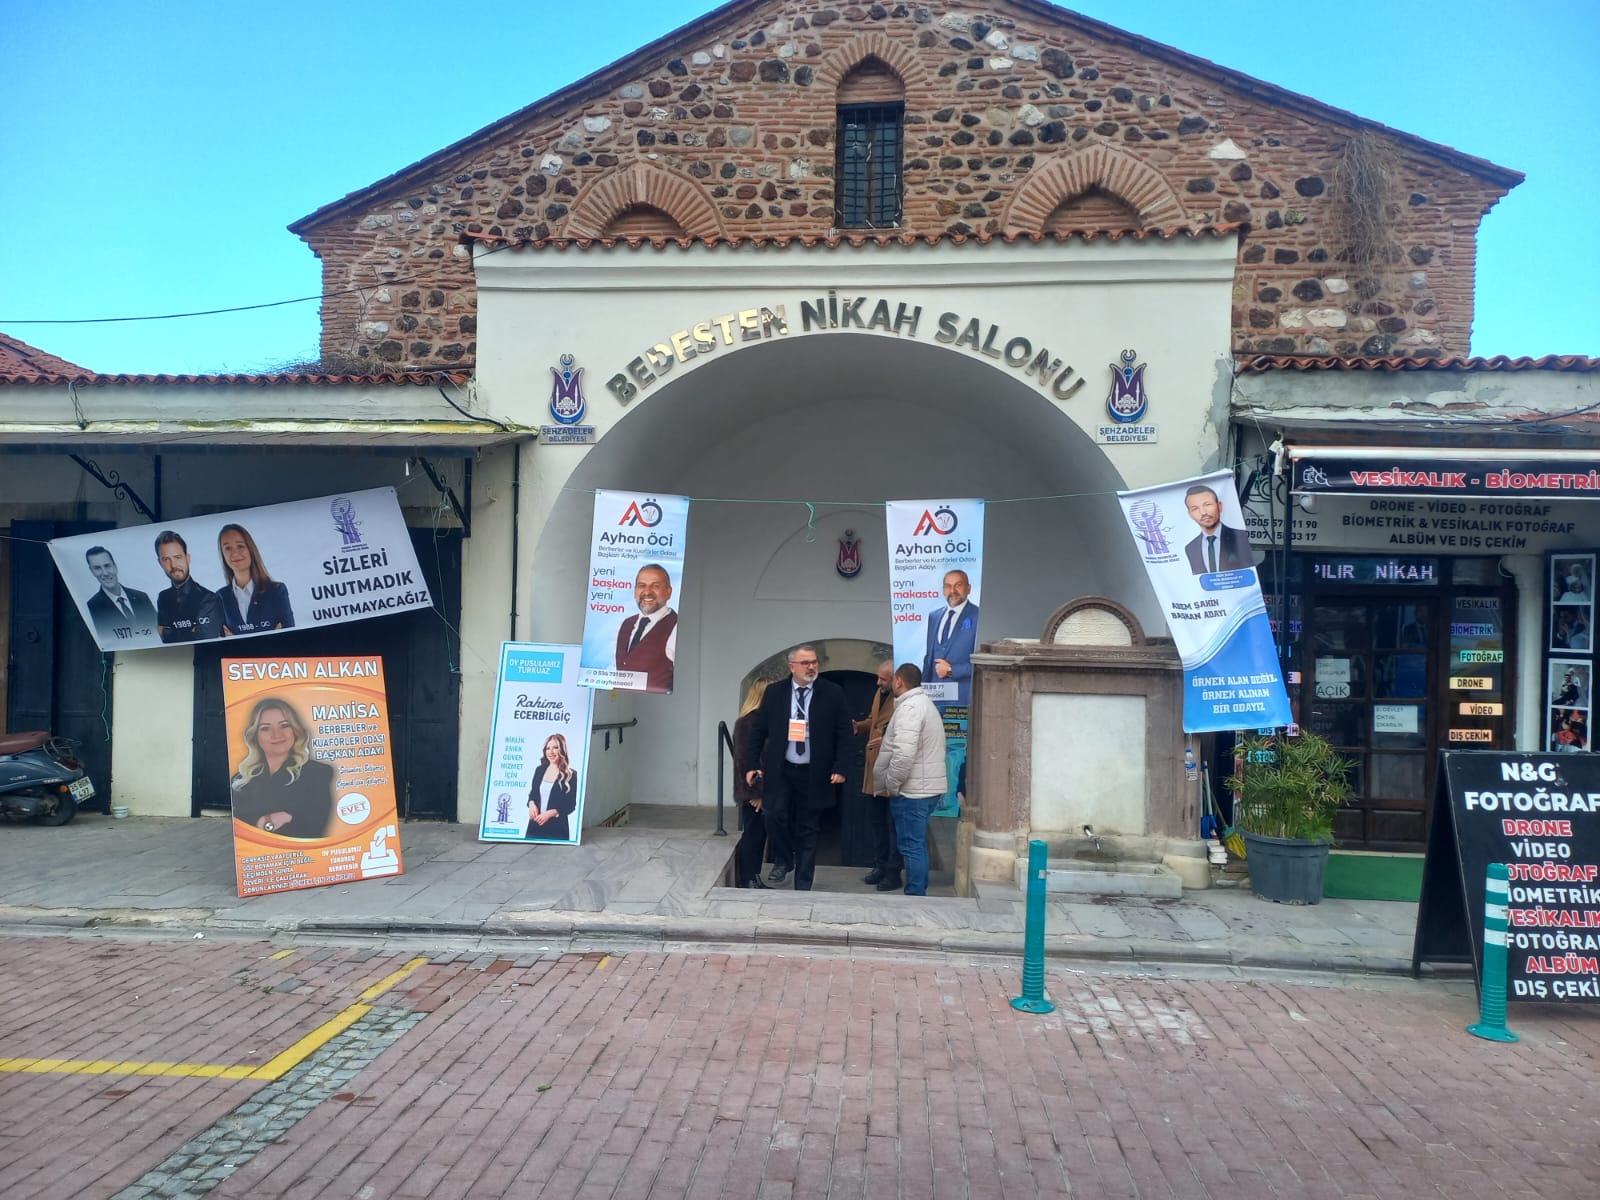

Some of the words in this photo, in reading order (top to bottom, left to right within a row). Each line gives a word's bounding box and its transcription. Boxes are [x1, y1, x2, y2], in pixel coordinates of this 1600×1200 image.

[606, 304, 789, 406] BEDESTEN
[799, 289, 923, 337] NİKAH
[934, 311, 1086, 400] SALONU
[1350, 467, 1466, 489] VESİKALIK
[1370, 500, 1415, 512] DRONE
[1427, 500, 1467, 514] VİDEO
[1479, 501, 1552, 516] FOTOĞRAF
[1246, 518, 1269, 527] 0505
[1306, 520, 1318, 528] 90
[1342, 515, 1416, 529] BİOMETRİK
[1419, 519, 1428, 529] &
[1431, 518, 1503, 532] VESİKALIK
[1506, 519, 1576, 534] FOTOĞRAF
[600, 531, 644, 548] Ayhan
[1306, 533, 1317, 541] 17
[1390, 532, 1436, 546] ALBÜM
[1440, 536, 1456, 546] VE
[1460, 536, 1481, 548] DIŞ
[1485, 534, 1527, 549] ÇEKİM
[896, 542, 942, 557] Ayhan
[323, 547, 388, 576] SİZLERİ
[593, 566, 615, 577] yeni
[1376, 561, 1433, 579] NİKAH
[311, 570, 414, 602] UNUTMADIK
[592, 577, 632, 590] başkan
[893, 579, 914, 590] aynı
[591, 590, 613, 601] yeni
[893, 590, 939, 599] makasta
[312, 589, 429, 621] UNUTMAYACAĞIZ
[590, 602, 625, 614] vizyon
[893, 602, 914, 612] aynı
[894, 614, 922, 624] yolda
[1203, 609, 1227, 619] ADAYI
[172, 619, 192, 630] 1989
[113, 627, 132, 640] 1977
[1461, 650, 1503, 662] FOTOĞRAF
[228, 660, 308, 681] SEVCAN
[314, 660, 379, 678] ALKAN
[1192, 676, 1226, 687] ÖRNEK
[1228, 674, 1249, 686] ALAN
[1457, 678, 1484, 688] DRONE
[1202, 689, 1236, 700] ÖRNEK
[1238, 688, 1270, 699] ALINAN
[1316, 686, 1347, 699] AÇIK
[516, 694, 564, 710] Rahime
[1213, 702, 1230, 714] BİR
[1233, 702, 1265, 713] ODAYIZ
[1470, 703, 1493, 715] VİDEO
[312, 701, 379, 721] MANİSA
[514, 709, 571, 724] ECERBİLGİÇ
[318, 724, 366, 735] BERBERLER
[1465, 730, 1490, 741] ÇEKİM
[362, 734, 385, 745] ODASI
[316, 748, 355, 762] BAŞKAN
[358, 746, 385, 758] ADAYI
[502, 753, 524, 761] GÜVEN
[1501, 761, 1557, 782] N&G
[1464, 787, 1600, 813] FOTOĞRAF
[340, 802, 367, 817] EVET
[1502, 819, 1573, 837] DRONE
[1510, 838, 1571, 859] VİDEO
[1508, 862, 1598, 882] OTOĞRAF
[1526, 953, 1598, 975] ALBÜM
[1514, 980, 1549, 999] DIŞ
[1553, 978, 1600, 1001] ÇEKİ
